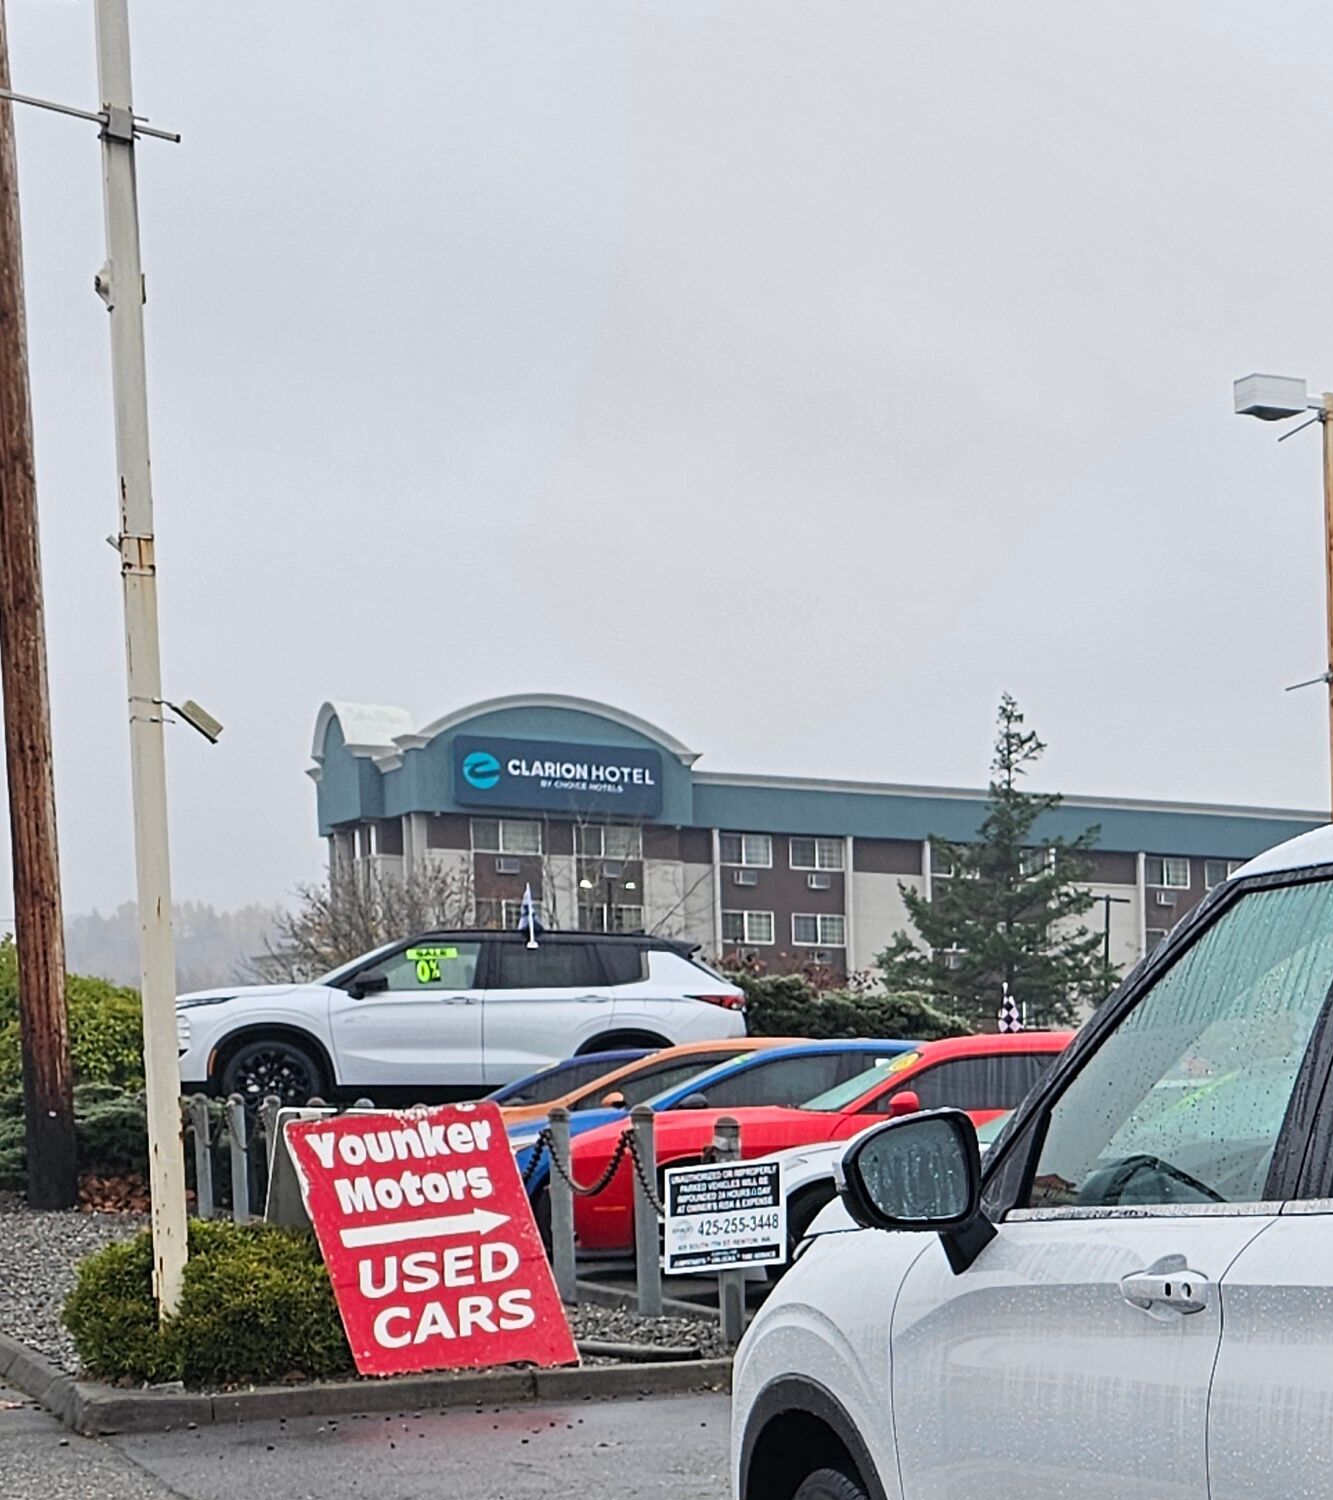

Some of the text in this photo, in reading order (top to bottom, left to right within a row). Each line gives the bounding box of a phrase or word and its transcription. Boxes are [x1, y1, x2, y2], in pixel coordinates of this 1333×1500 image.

[508, 759, 654, 785] CLARION HOTEL
[540, 779, 623, 793] BY CHOICE HOTELS
[416, 959, 441, 983] 0%
[305, 1119, 492, 1168] Younker
[334, 1167, 493, 1214] Motors
[680, 1183, 706, 1193] PARKED
[708, 1179, 739, 1191] VEHICLES
[698, 1213, 779, 1236] 425-255-3448
[359, 1242, 520, 1299] USED
[373, 1289, 535, 1349] CARS
